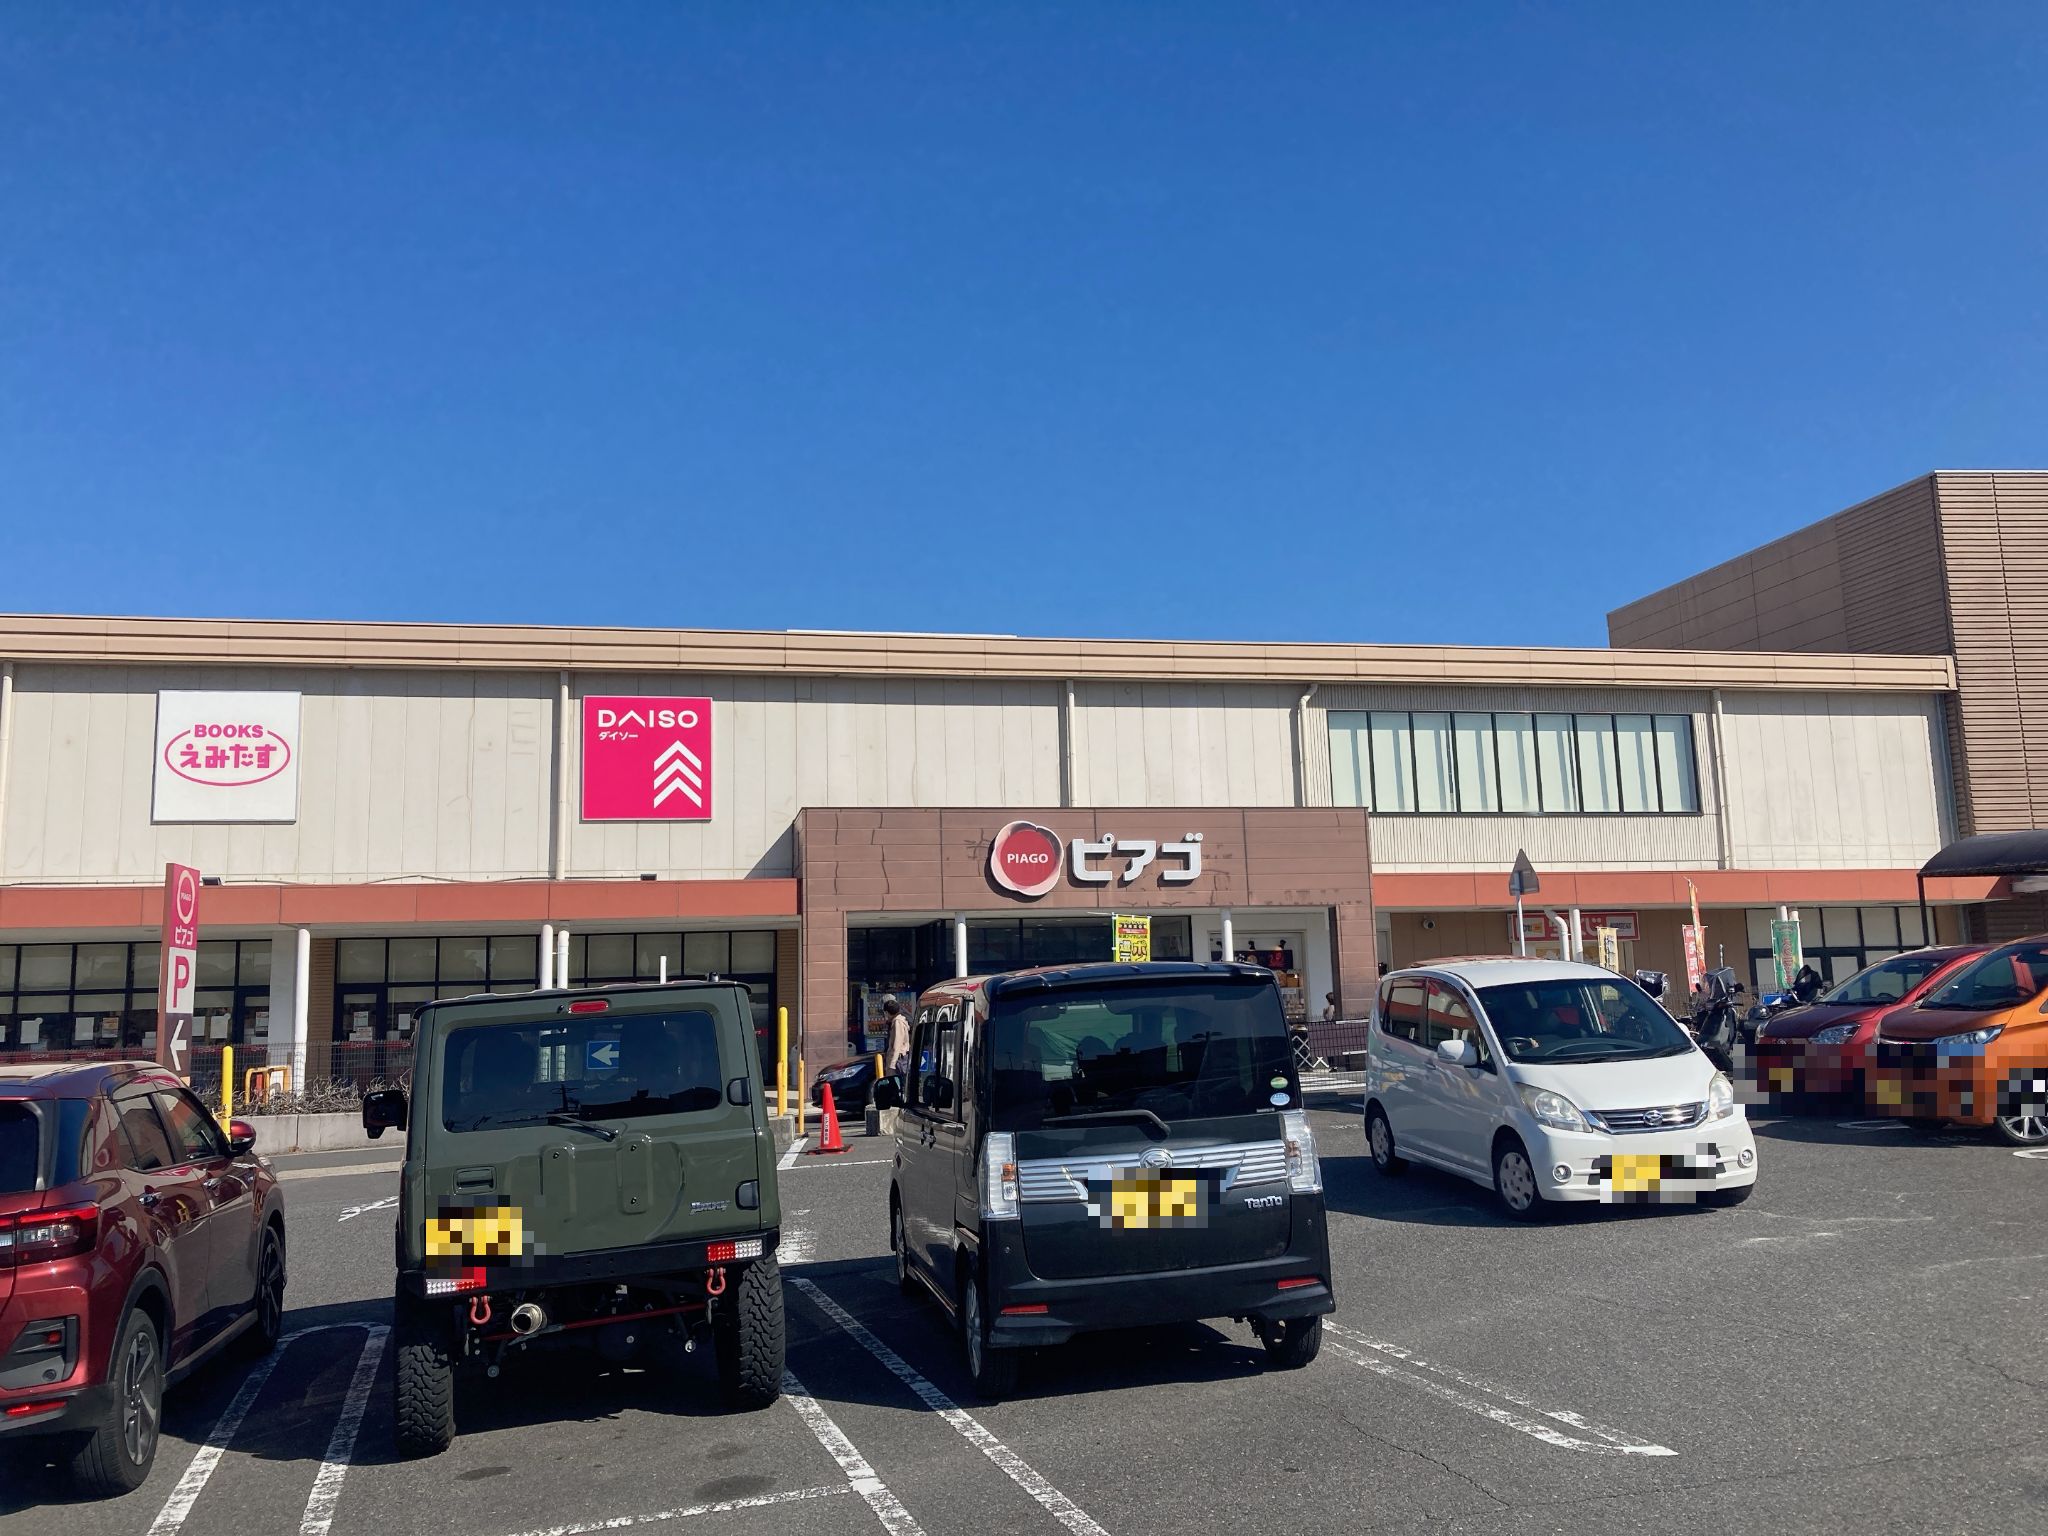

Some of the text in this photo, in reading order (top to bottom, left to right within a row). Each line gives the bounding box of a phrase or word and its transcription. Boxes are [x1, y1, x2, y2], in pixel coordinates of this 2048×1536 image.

[597, 709, 699, 729] DAISO
[194, 724, 264, 738] BOOKS
[598, 731, 639, 741] ダイソー
[180, 743, 278, 769] えみたす
[1006, 852, 1049, 865] PIAGO
[1072, 832, 1204, 882] ピアゴ
[174, 926, 194, 946] ピアゴ
[173, 956, 190, 1008] P
